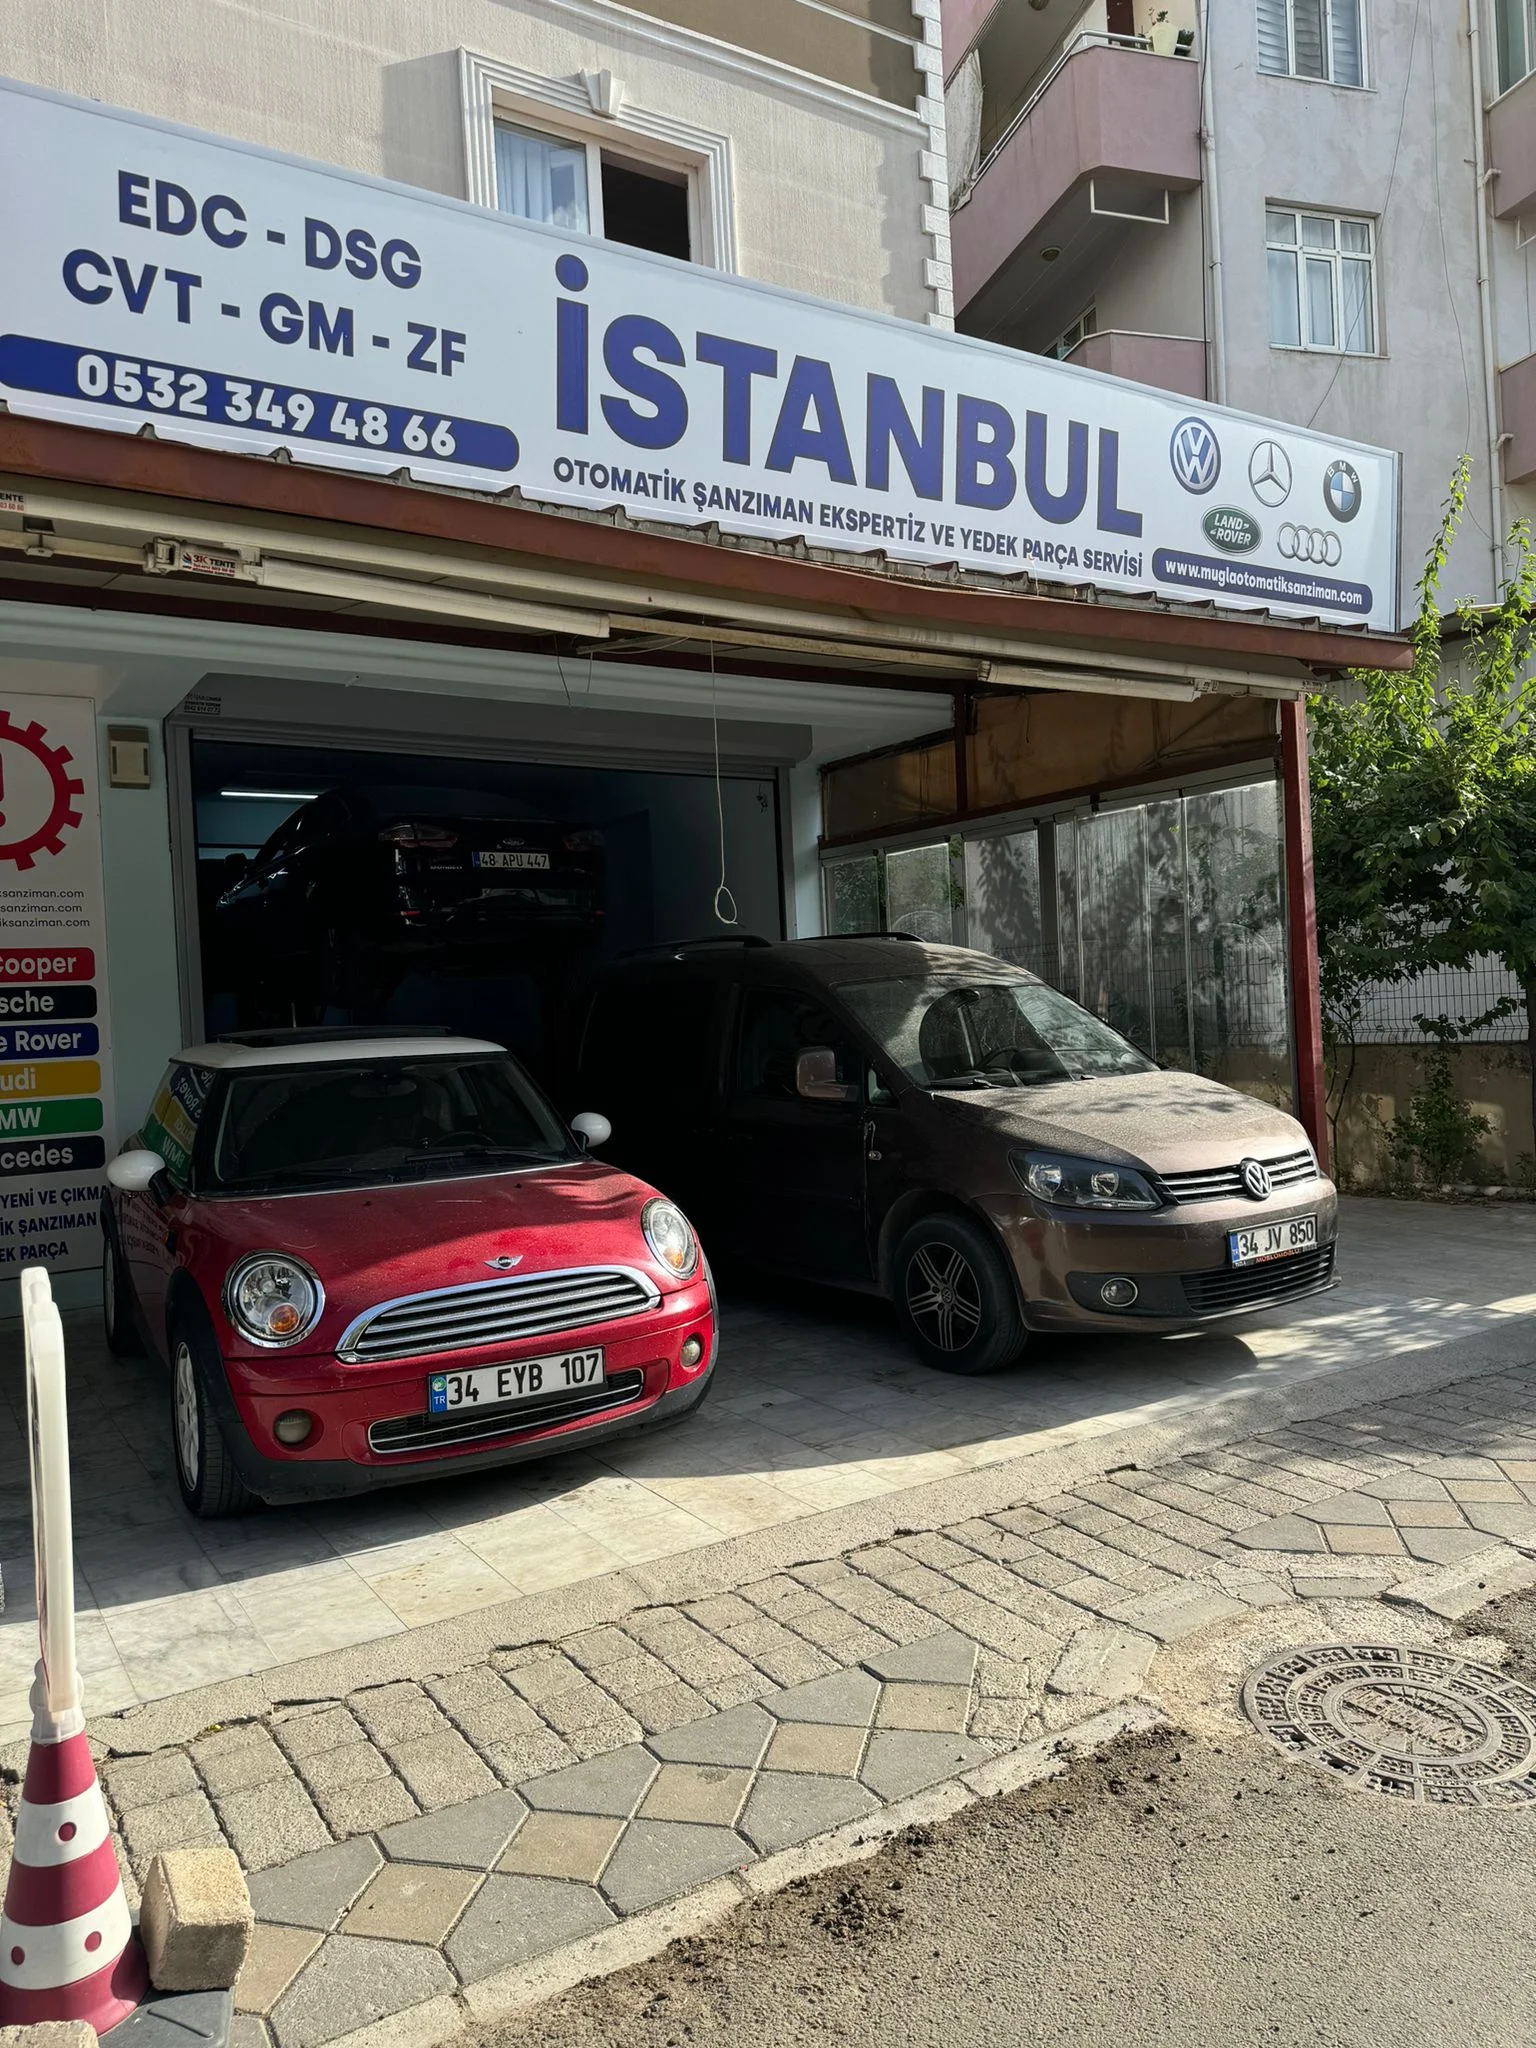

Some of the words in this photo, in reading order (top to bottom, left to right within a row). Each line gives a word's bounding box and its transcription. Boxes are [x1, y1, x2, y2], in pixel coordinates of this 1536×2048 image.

[118, 169, 248, 249] EDC
[266, 229, 287, 246] -
[304, 216, 423, 290] DSG
[62, 249, 203, 325] CVT
[220, 302, 242, 320] -
[259, 293, 355, 358] GM
[372, 334, 391, 350] -
[406, 322, 468, 377] ZF
[76, 354, 208, 417] 0532
[224, 380, 316, 432] 349
[329, 404, 390, 446] 48
[402, 421, 457, 457] 66
[555, 253, 1143, 538] İSTANBUL
[553, 456, 687, 504] OTOMATİK
[692, 480, 814, 525] ŞANZIMAN
[819, 503, 925, 544] EKSPERTİZ
[930, 522, 956, 549] VE
[959, 526, 1018, 558] YEDEK
[1022, 536, 1079, 569] PARÇA
[1082, 547, 1144, 578] SERVİSİ
[1213, 512, 1244, 530] LAND
[1216, 529, 1252, 547] ROVER
[209, 558, 236, 569] TENTE
[1165, 557, 1363, 606] www.muglaotomatiksanziman.com
[481, 853, 496, 866] 48
[502, 854, 523, 867] APU
[527, 855, 547, 868] 447
[15, 1029, 82, 1052] Rover
[0, 1068, 37, 1092] udi
[0, 1144, 74, 1168] cedes
[0, 1188, 34, 1209] YENİ
[38, 1190, 57, 1205] VE
[18, 1212, 97, 1237] ŞANZIMAN
[1239, 1231, 1259, 1257] 34
[1265, 1227, 1282, 1252] JV
[1289, 1219, 1315, 1246] 850
[20, 1241, 69, 1260] PARÇA
[434, 1395, 446, 1405] TR
[448, 1374, 480, 1405] 34
[497, 1363, 543, 1398] EYB
[560, 1352, 600, 1386] 107
